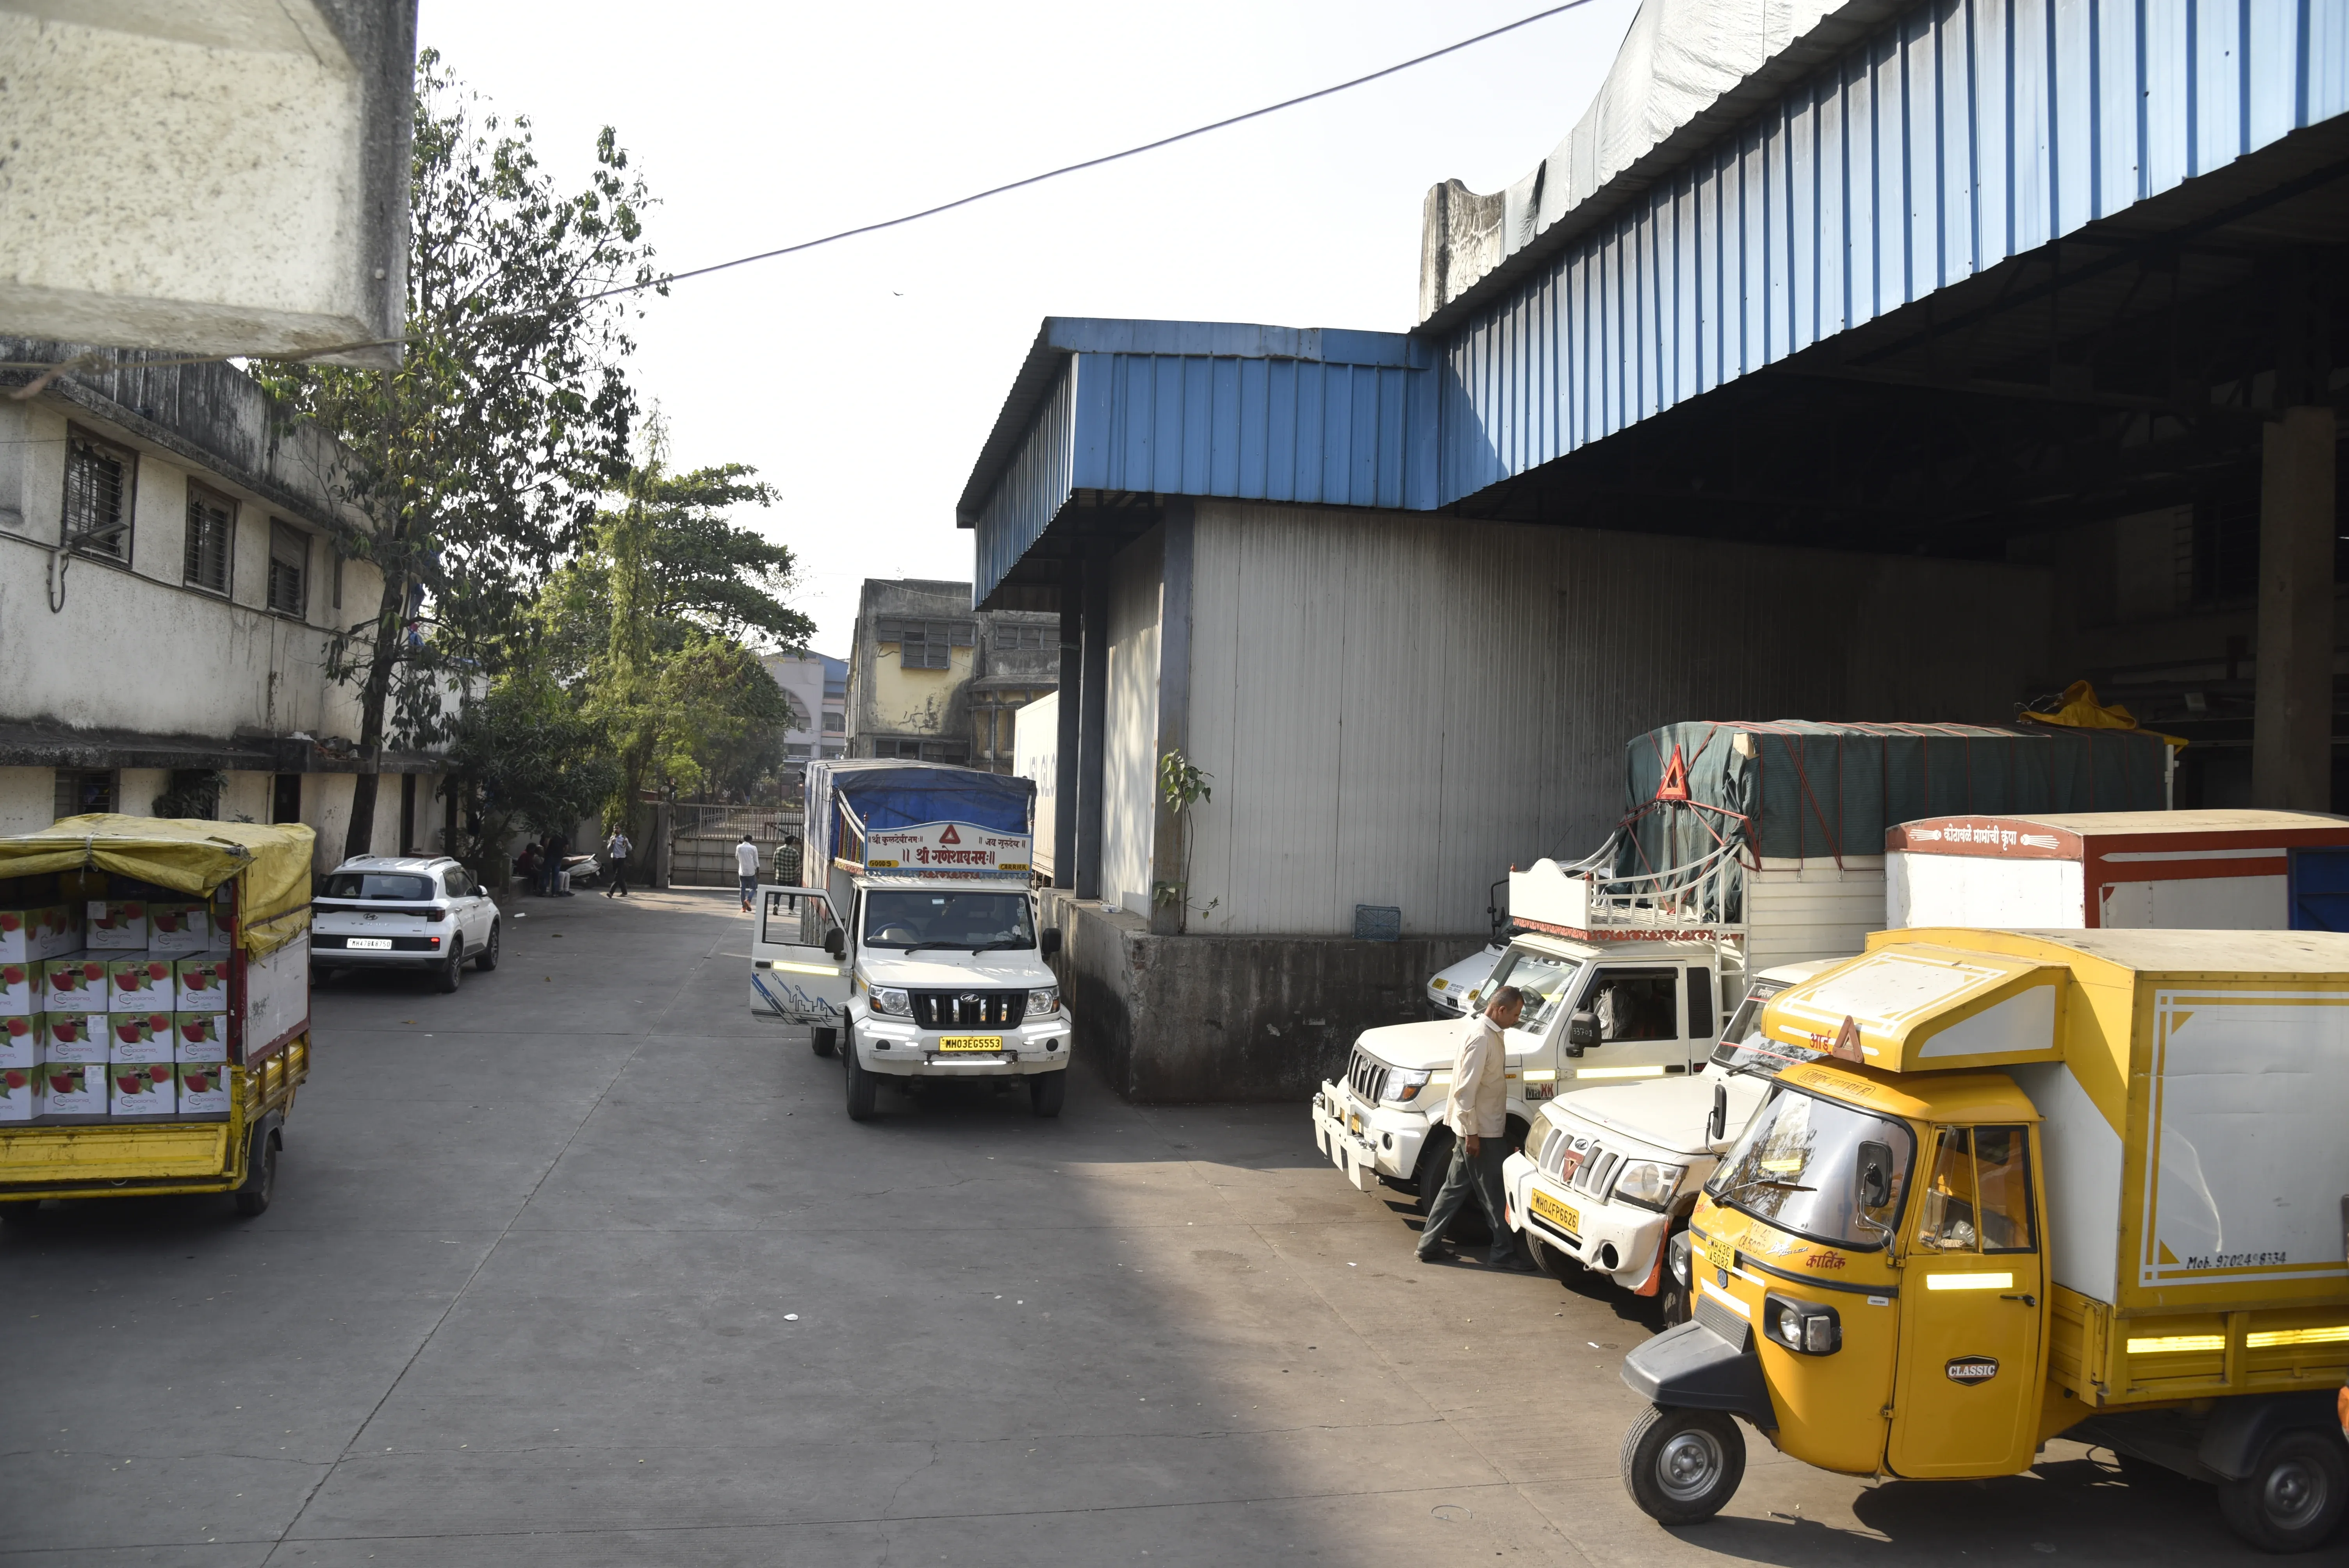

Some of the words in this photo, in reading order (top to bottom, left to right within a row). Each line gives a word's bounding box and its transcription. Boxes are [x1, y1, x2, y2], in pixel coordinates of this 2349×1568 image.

[985, 838, 996, 846] जय
[1973, 825, 2000, 844] मामांची
[2001, 830, 2017, 851] कृपा
[915, 846, 930, 864] श्री
[932, 845, 971, 865] गणेशाय
[1446, 996, 1459, 1009] TATA
[1573, 1028, 1593, 1037] 33701
[946, 1039, 1000, 1048] MH03EG5553
[1809, 1030, 1832, 1055] आई
[1536, 1195, 1577, 1228] MH04FP6626
[1709, 1252, 1729, 1269] A5082
[1805, 1251, 1846, 1270] कार्तिक
[1948, 1365, 1995, 1376] CLASSIC
